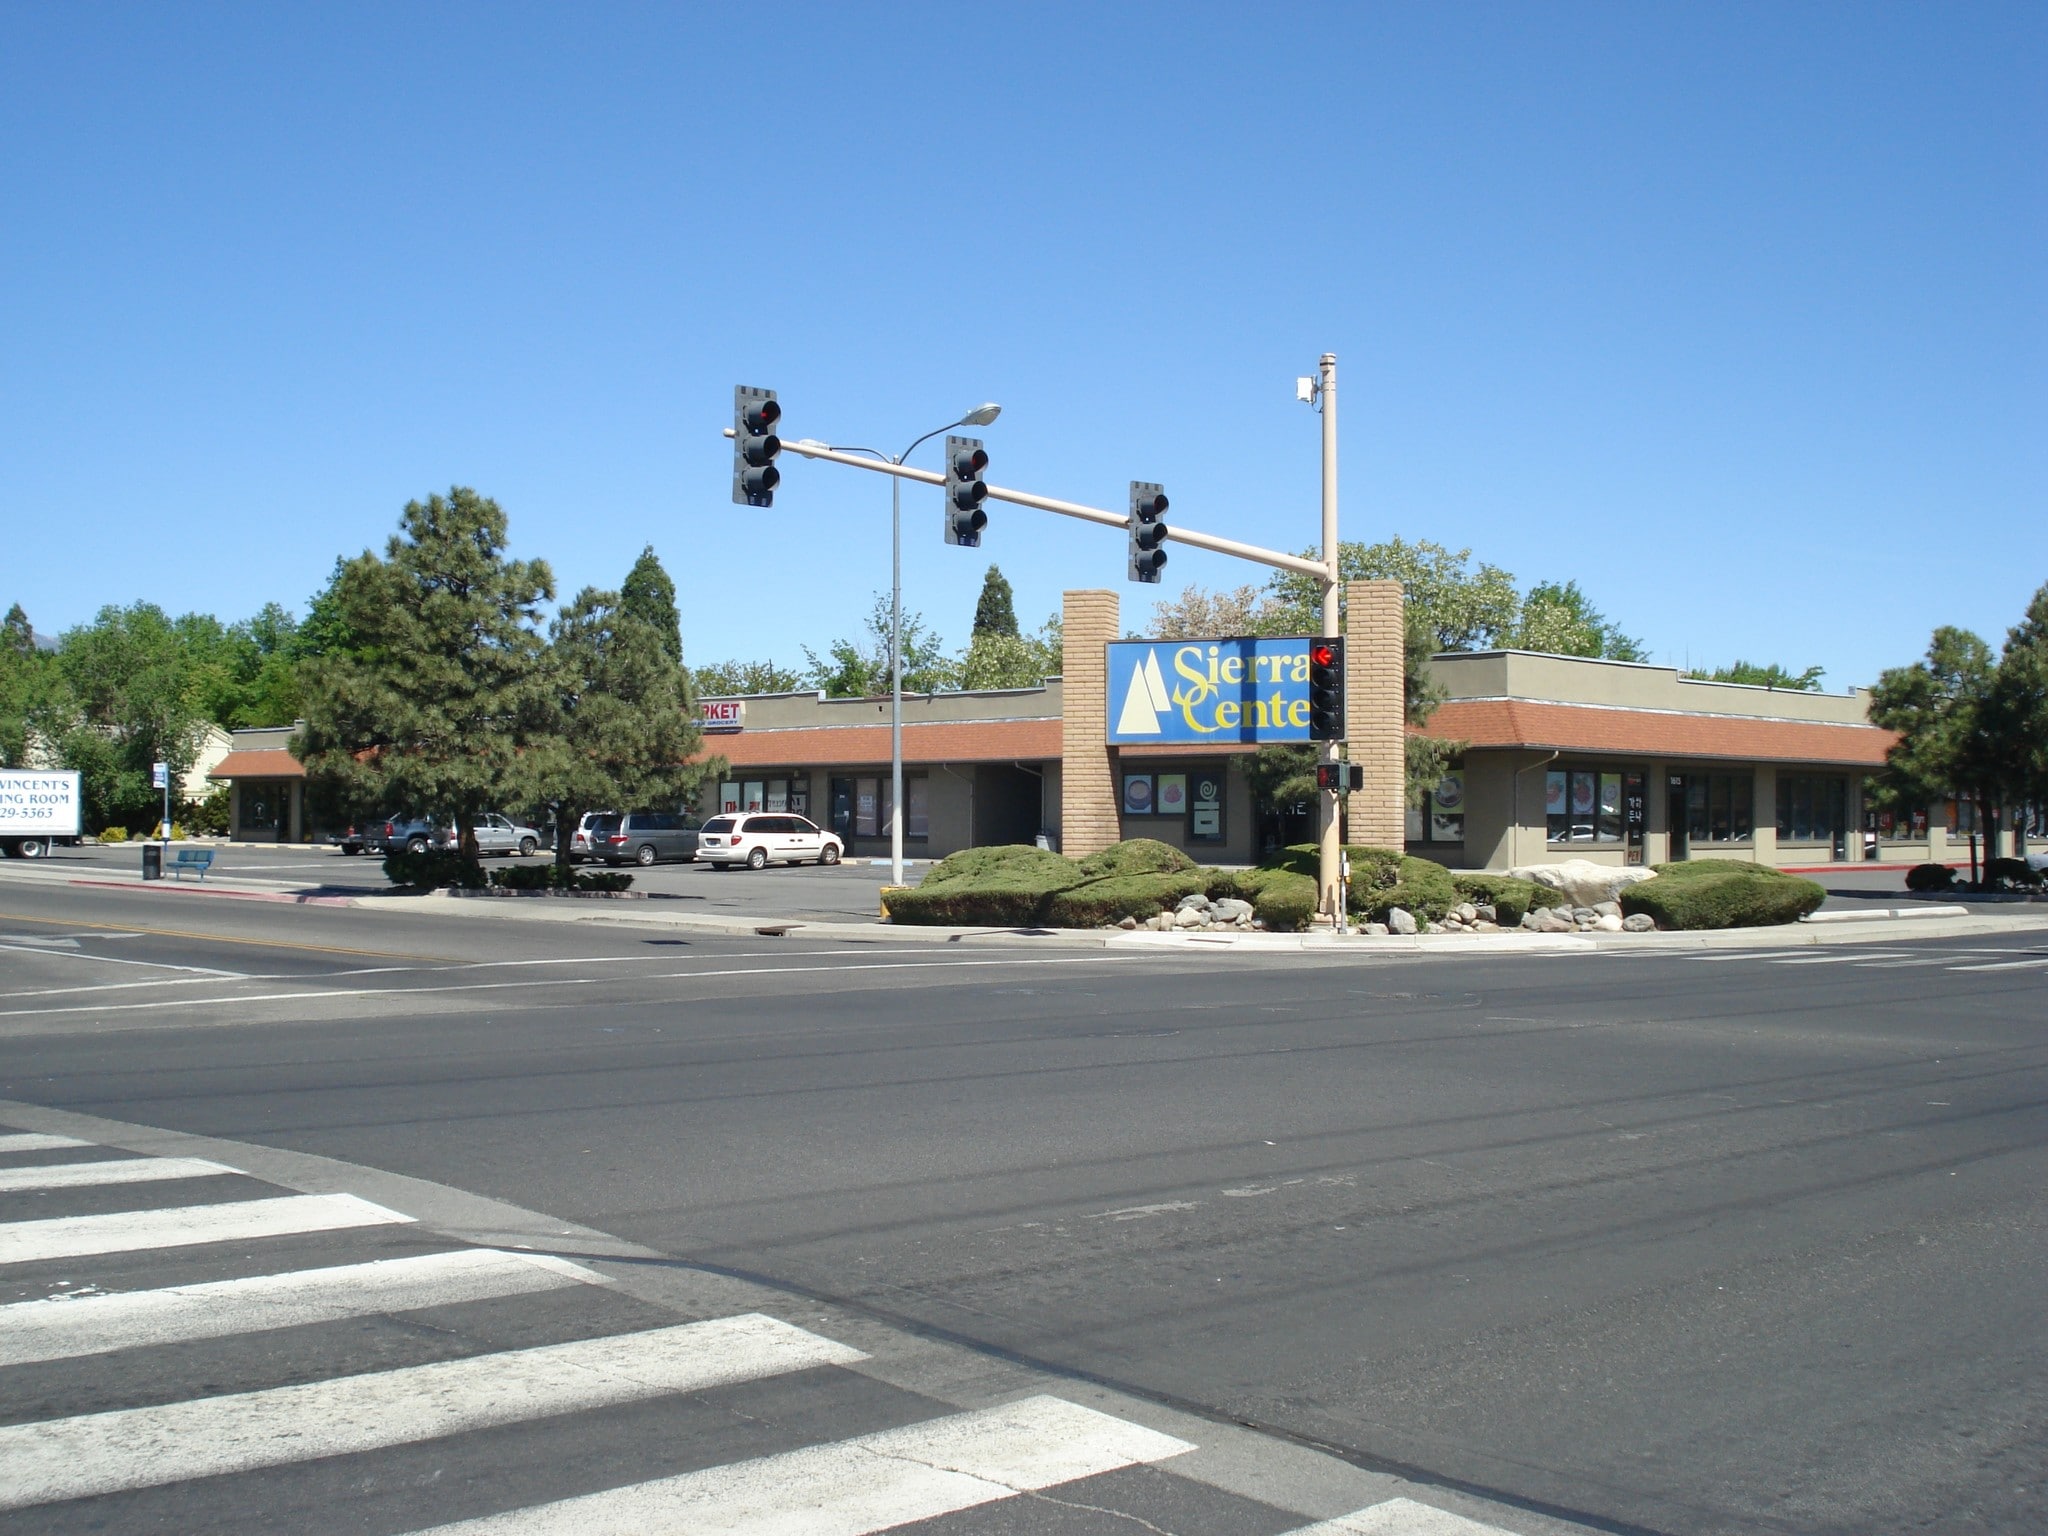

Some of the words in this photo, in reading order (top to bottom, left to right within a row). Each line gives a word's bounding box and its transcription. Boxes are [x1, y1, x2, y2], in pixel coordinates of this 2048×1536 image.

[1173, 646, 1310, 705] Sierra
[703, 703, 740, 719] RKET
[1182, 685, 1310, 733] Cente
[0, 780, 70, 791] VINCENT'S
[0, 794, 24, 804] ING
[29, 794, 70, 804] ROOM
[0, 807, 53, 819] 29-5363
